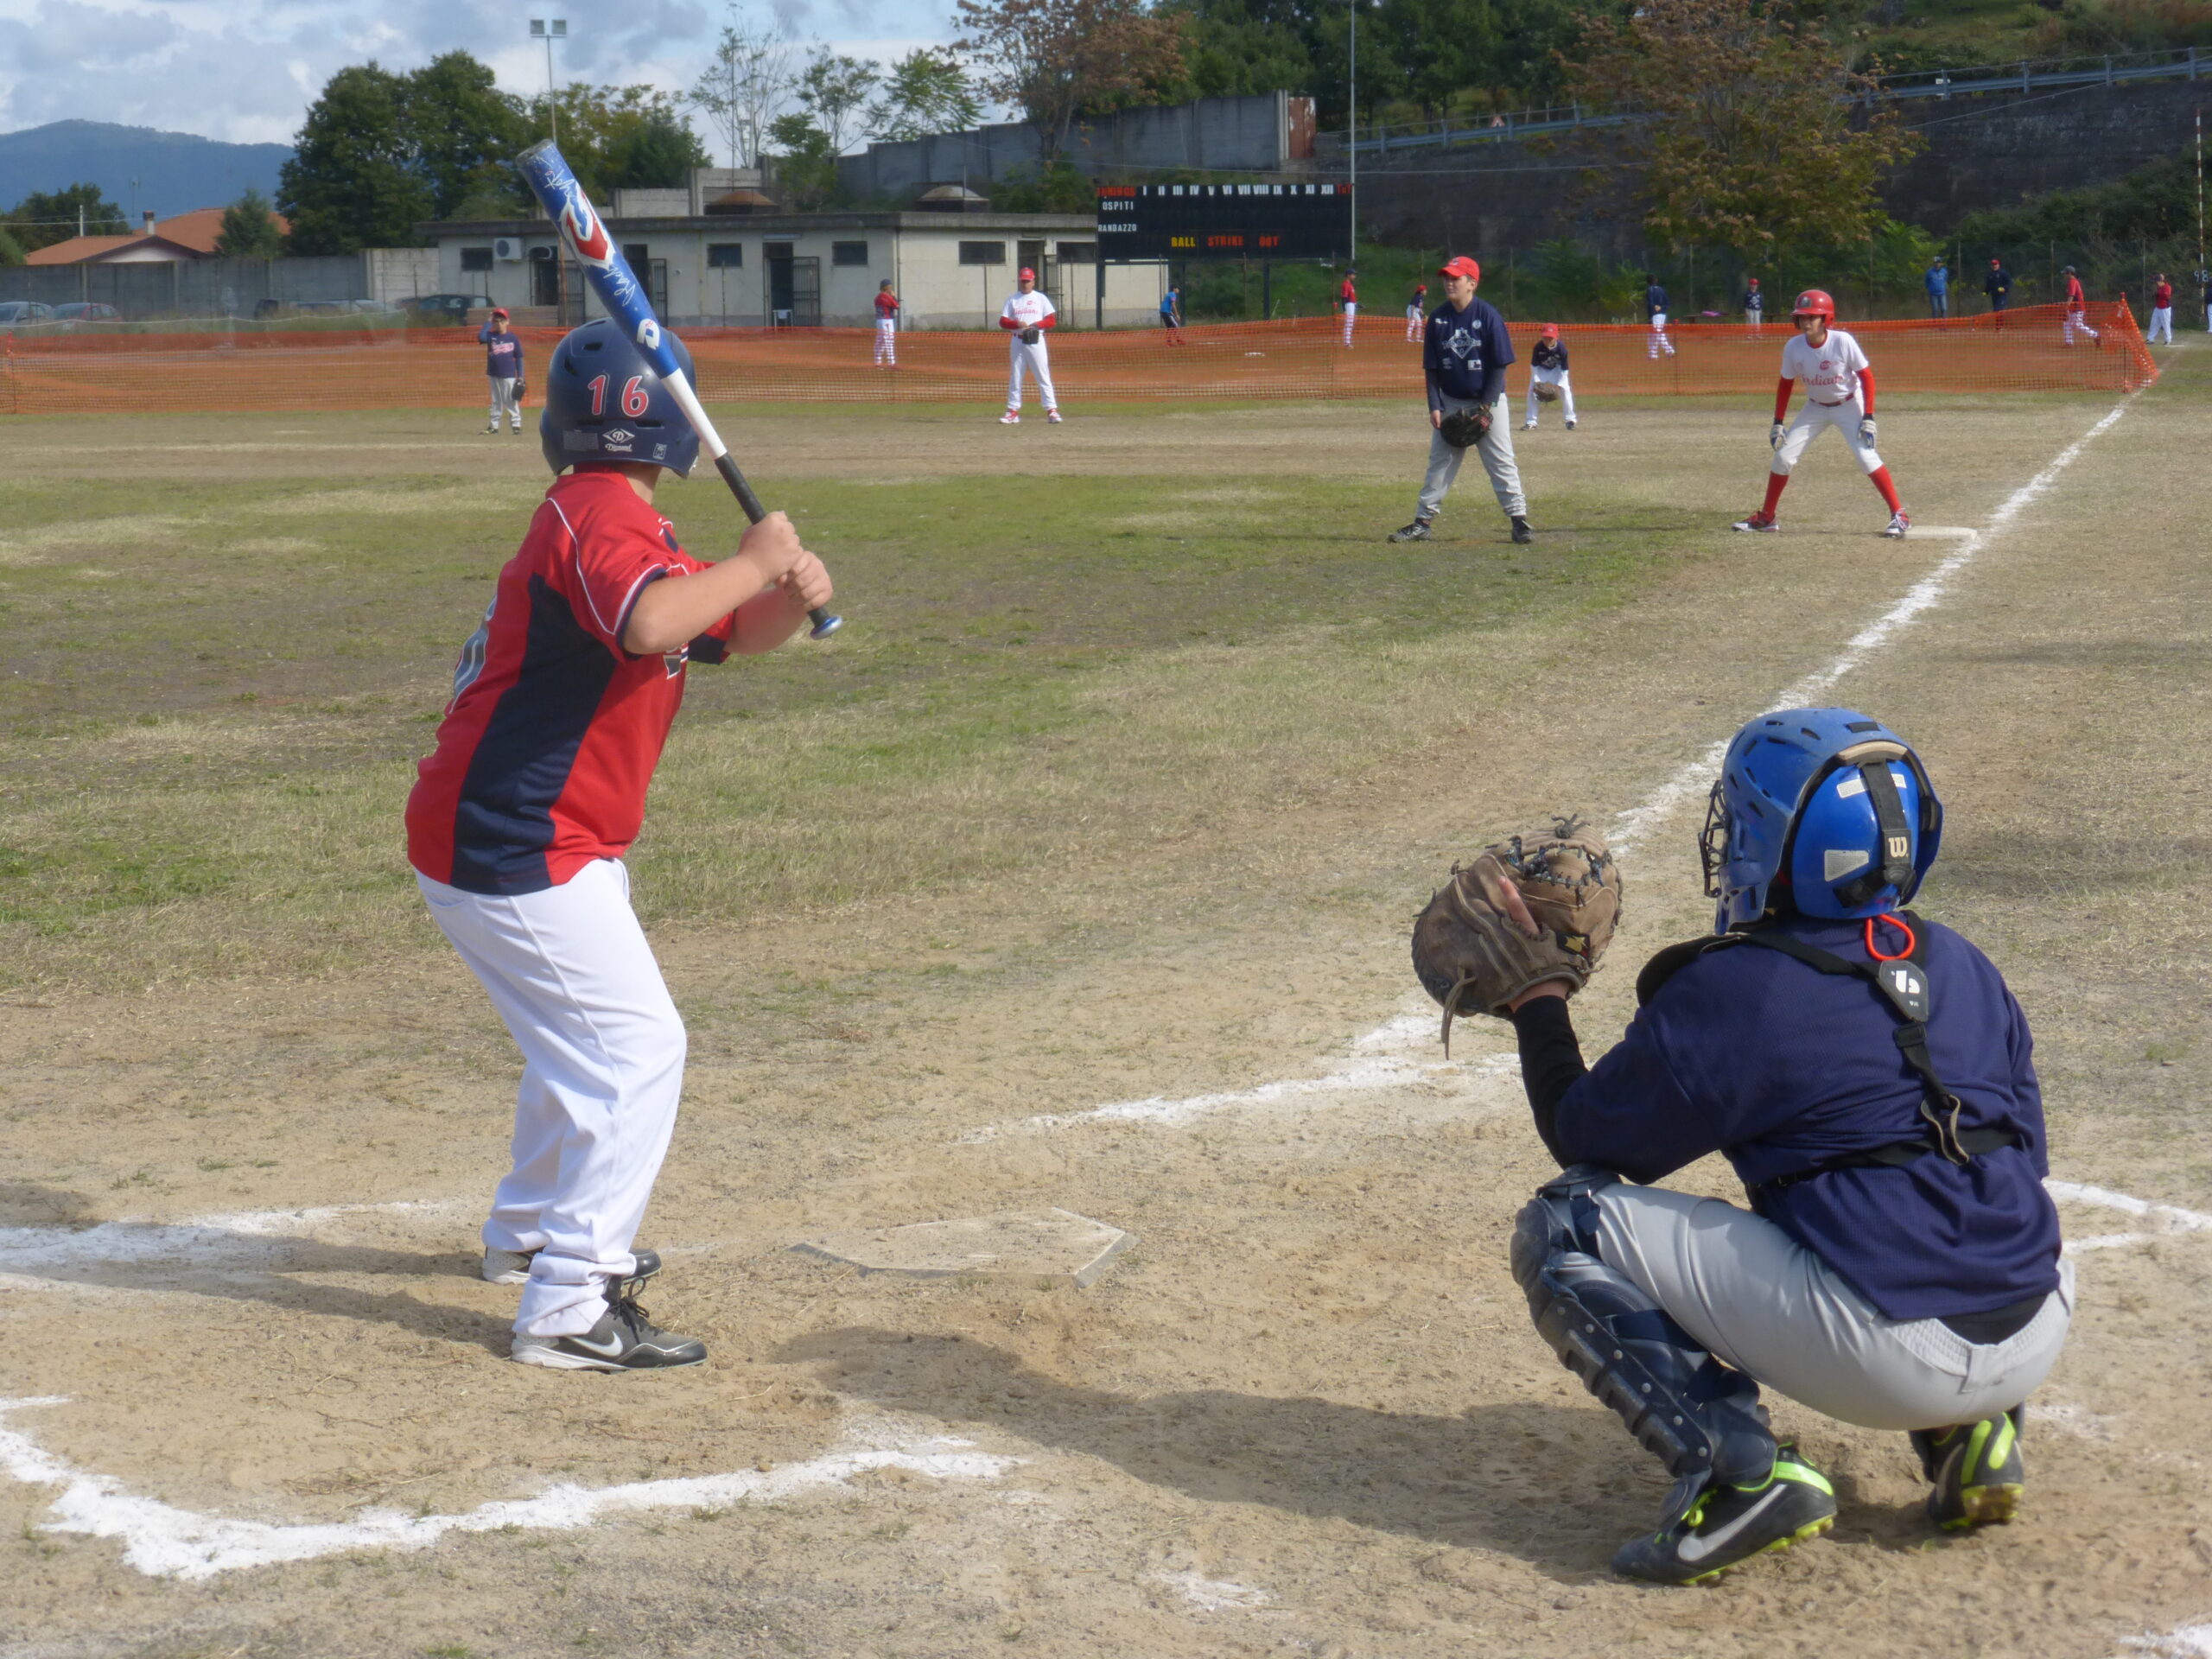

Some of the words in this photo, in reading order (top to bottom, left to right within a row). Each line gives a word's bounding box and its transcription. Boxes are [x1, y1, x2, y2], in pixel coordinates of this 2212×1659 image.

[1158, 186, 1165, 195] II
[1173, 185, 1183, 195] III
[1189, 185, 1199, 195] IV
[1207, 186, 1215, 196] V
[1222, 185, 1232, 195] VI
[1237, 185, 1250, 195] VII
[1253, 185, 1268, 195] VIII
[1273, 185, 1282, 194] IX
[1290, 185, 1297, 194] X
[1305, 185, 1315, 194] XI
[1321, 185, 1333, 194] XII
[1103, 200, 1134, 211] OSPITI
[1097, 224, 1137, 232] RANDAZZO
[1171, 237, 1195, 247] BALL
[1207, 235, 1244, 247] STRIKE
[588, 374, 649, 417] 16
